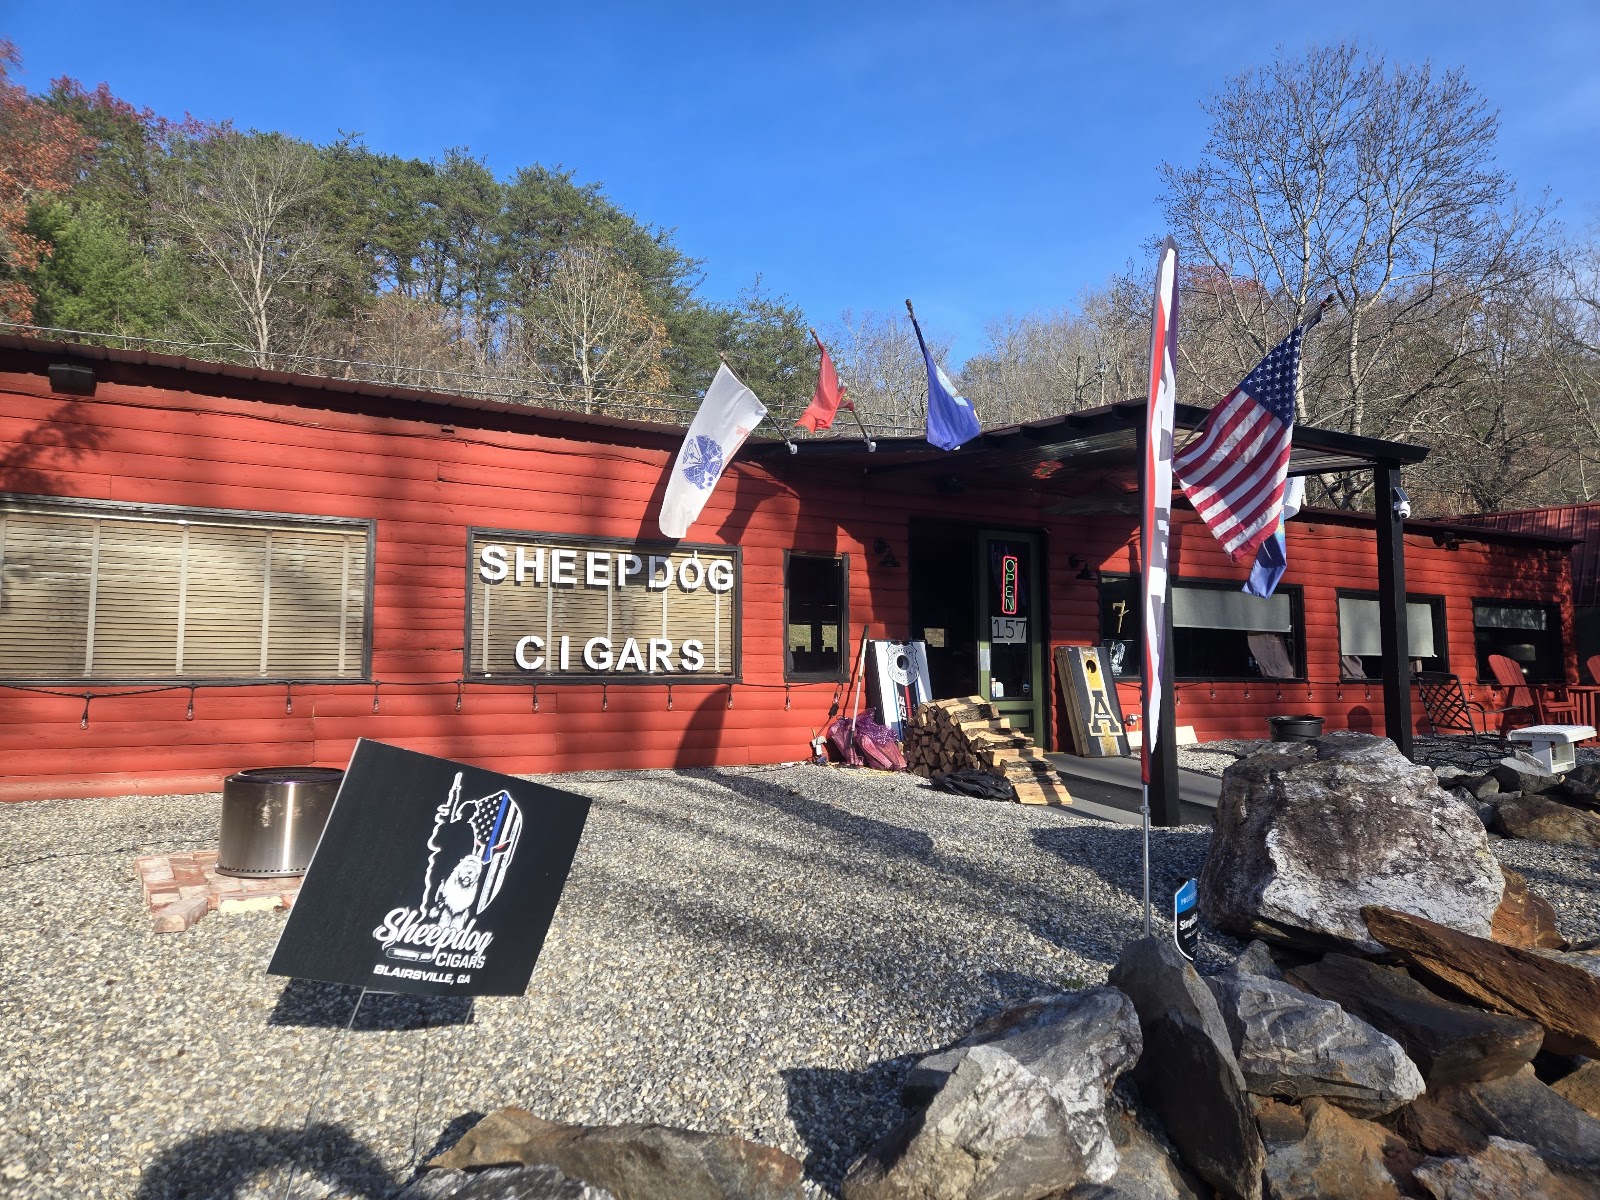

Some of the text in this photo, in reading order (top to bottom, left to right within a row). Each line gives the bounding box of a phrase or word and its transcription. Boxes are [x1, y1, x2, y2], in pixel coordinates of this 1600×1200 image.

[480, 545, 734, 591] SHEEPDOG
[1004, 559, 1015, 612] OPEN
[993, 620, 1026, 639] 157
[515, 636, 704, 671] CIGARS
[373, 907, 494, 959] Sheepdog
[373, 964, 471, 985] BLAIRSVILLE, GA
[435, 953, 486, 969] CIGARS
